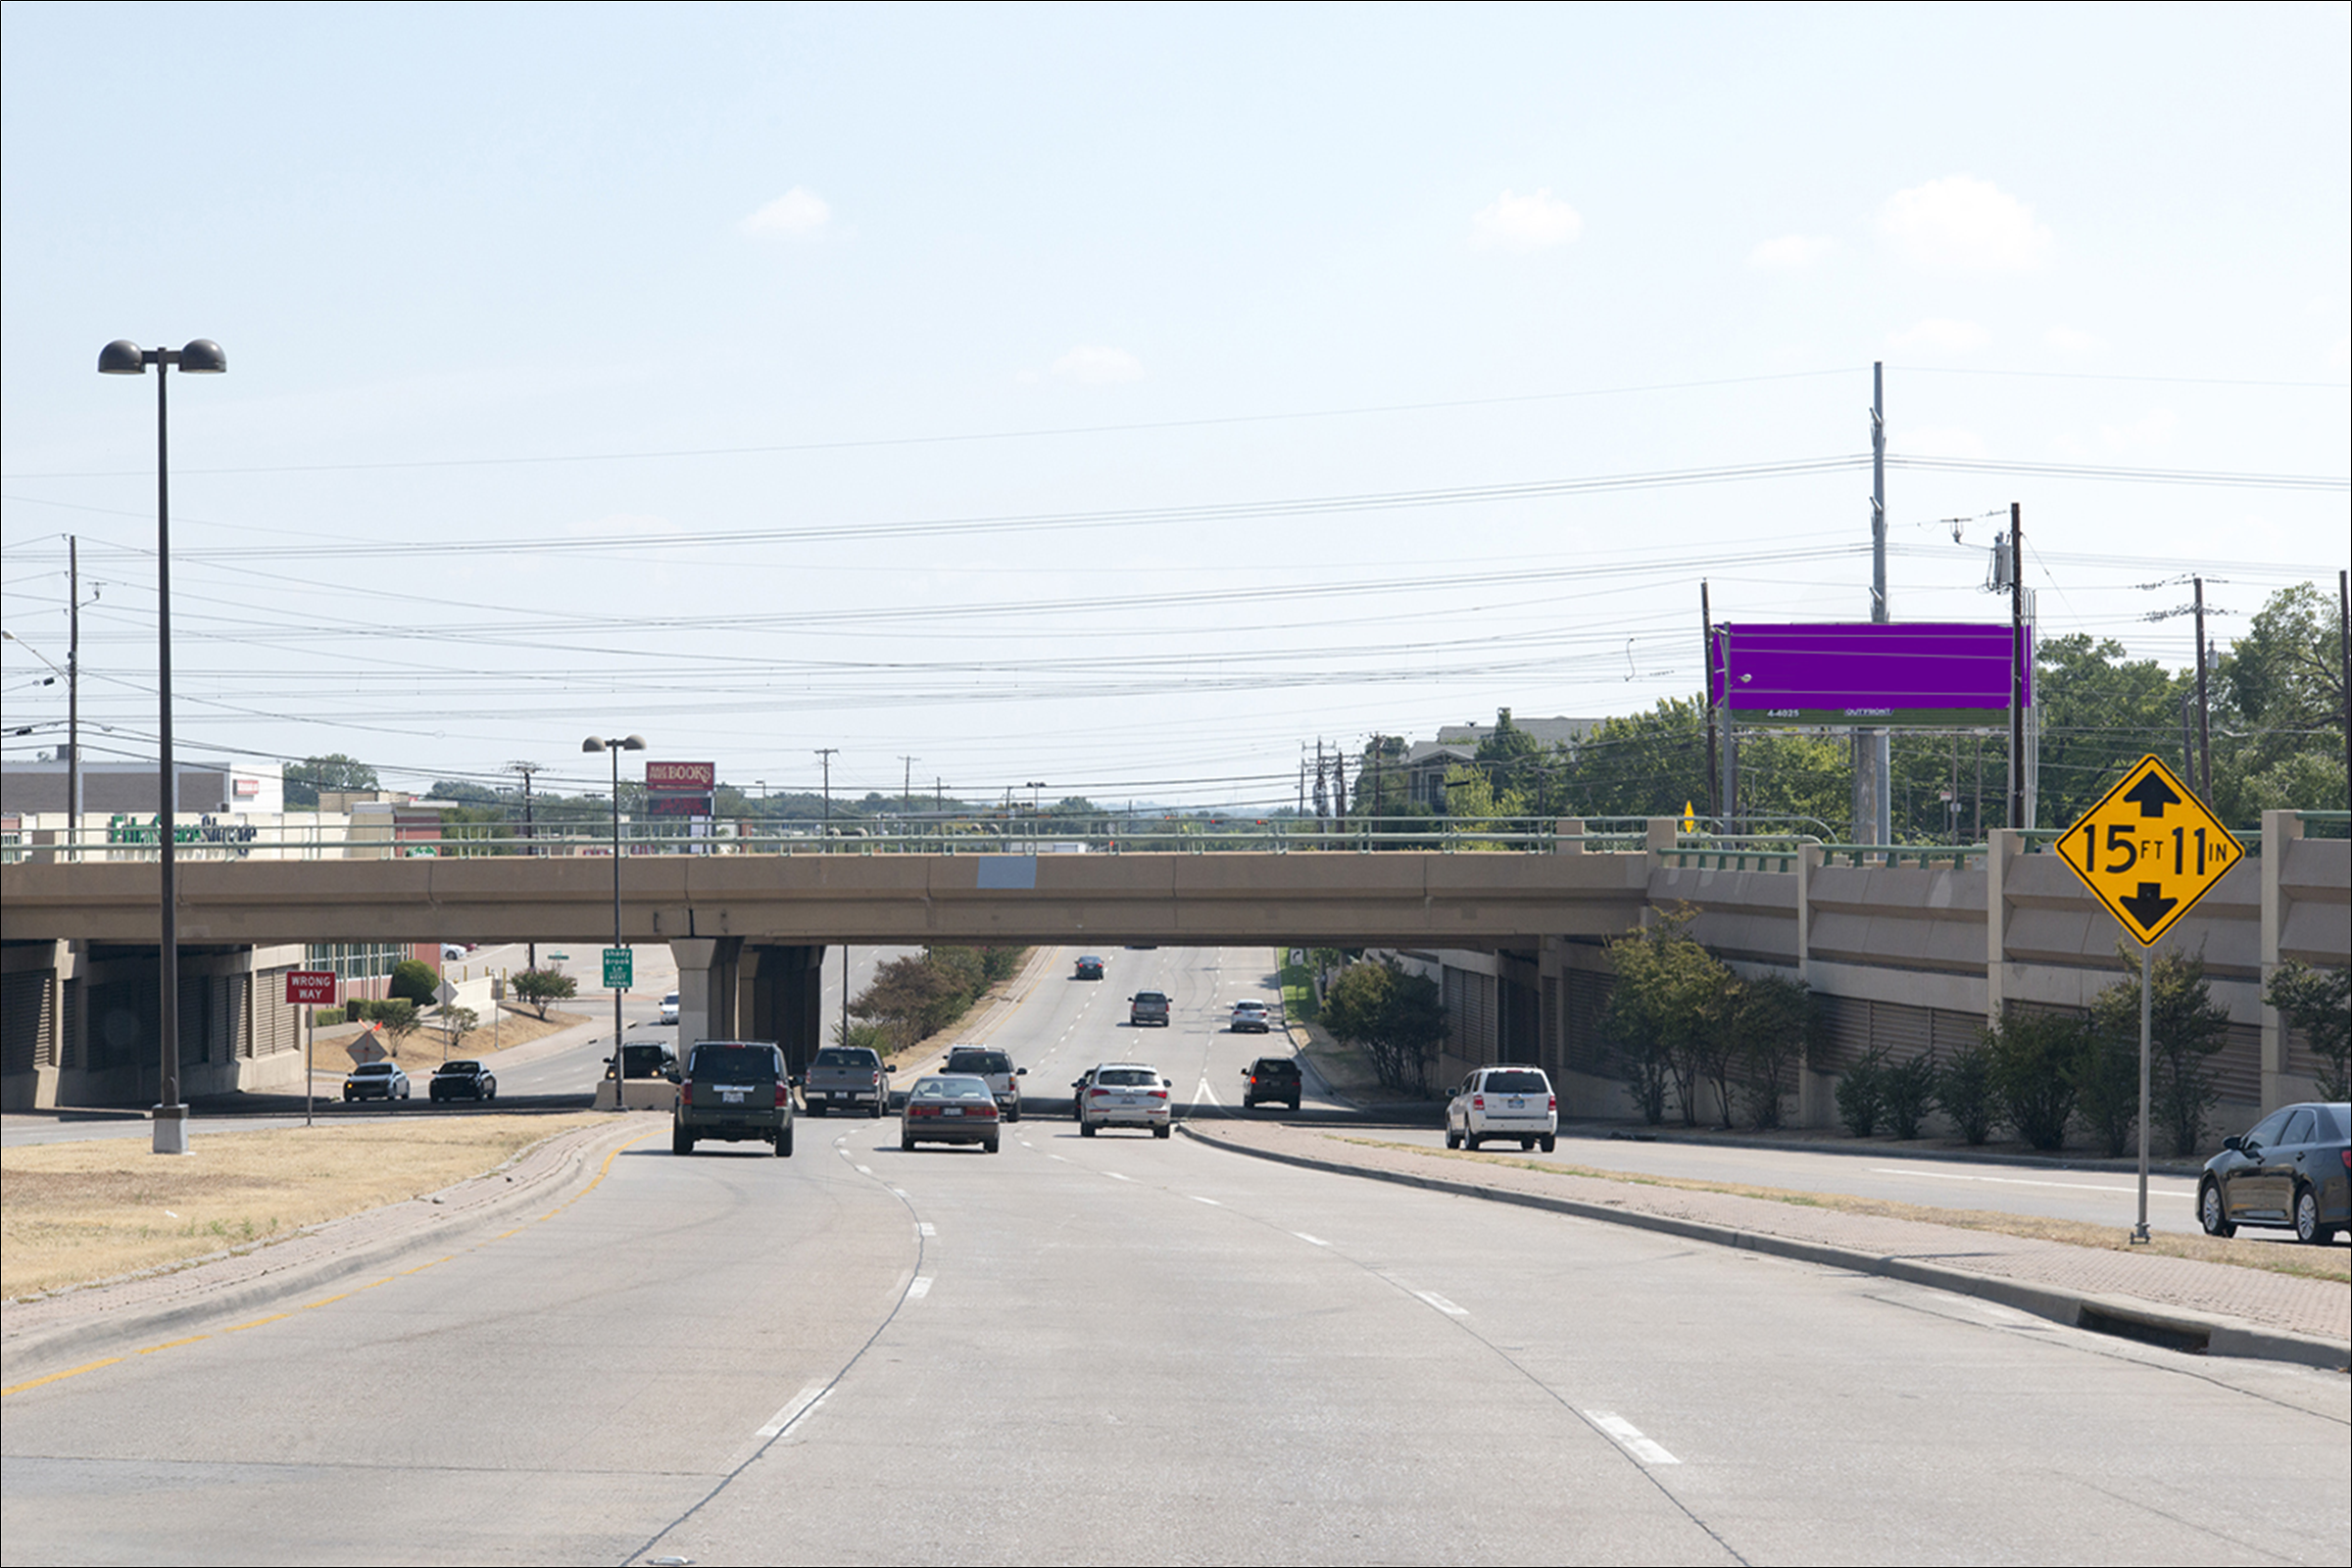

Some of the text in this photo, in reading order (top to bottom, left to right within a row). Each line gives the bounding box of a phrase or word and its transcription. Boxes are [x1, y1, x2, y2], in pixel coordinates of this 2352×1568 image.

[1767, 709, 1799, 718] 4-4025
[1845, 708, 1891, 716] OUTFRONT
[668, 765, 711, 783] BOOKS
[2083, 823, 2228, 875] 15 FT 11 IN
[291, 975, 331, 987] WRONG
[298, 989, 322, 1000] WAY
